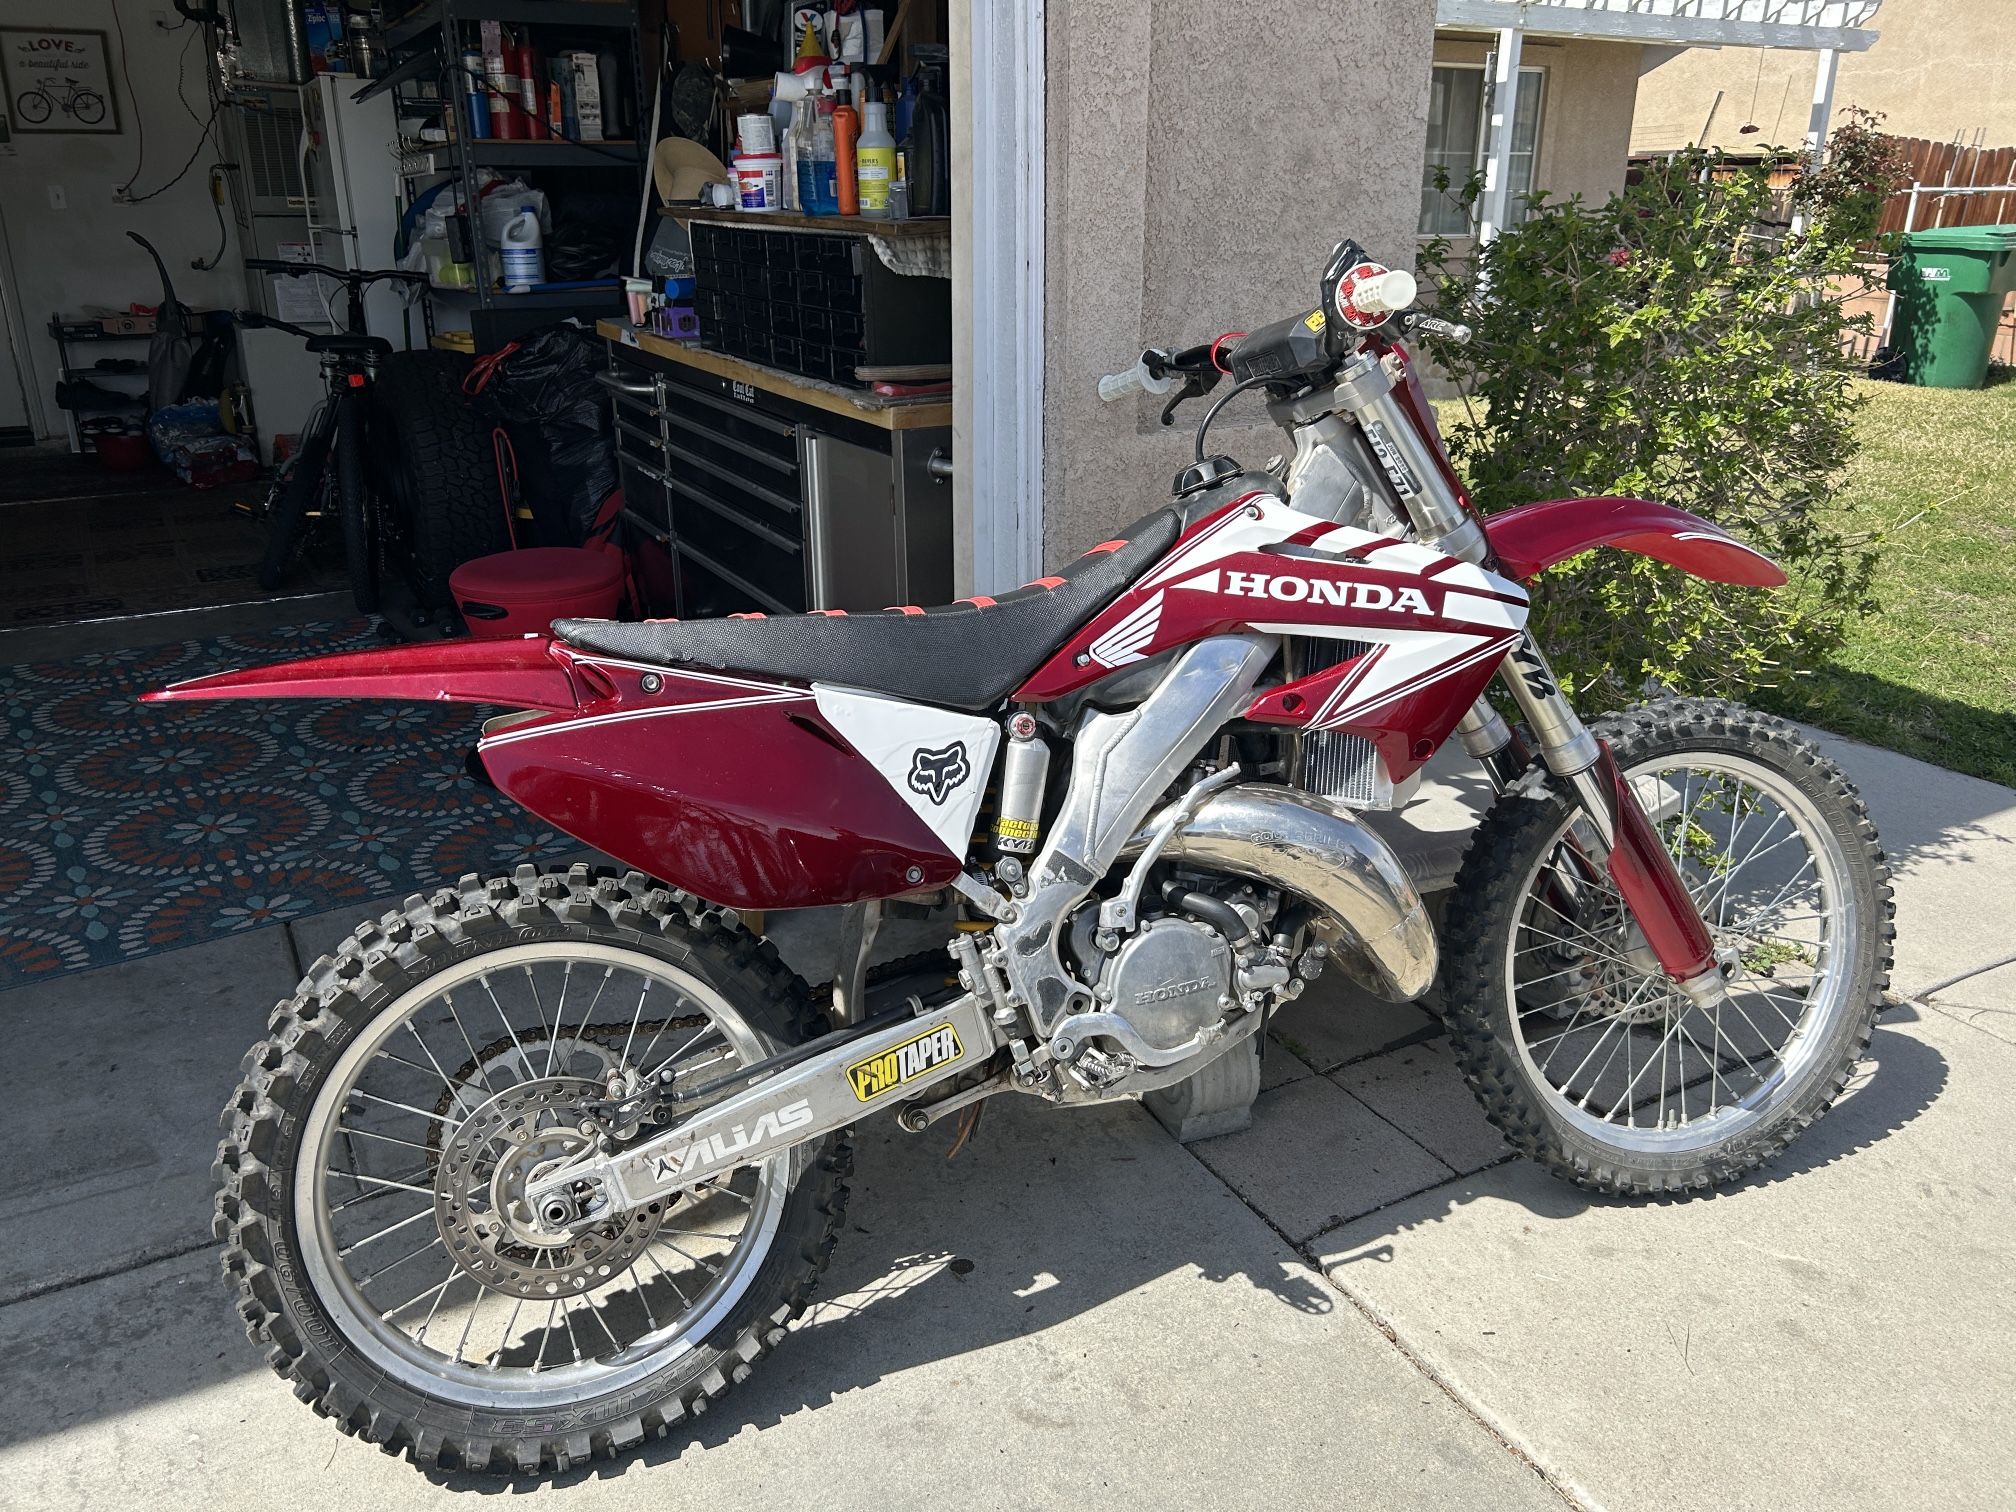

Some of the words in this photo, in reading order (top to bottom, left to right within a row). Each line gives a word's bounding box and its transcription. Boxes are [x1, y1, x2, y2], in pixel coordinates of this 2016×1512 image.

[28, 38, 75, 53] LOVE
[28, 58, 69, 72] beautiful
[70, 58, 90, 70] ride
[1418, 318, 1447, 331] ARC
[1224, 570, 1435, 616] HONDA
[997, 836, 1034, 850] KYB
[1134, 975, 1217, 1006] HONDA
